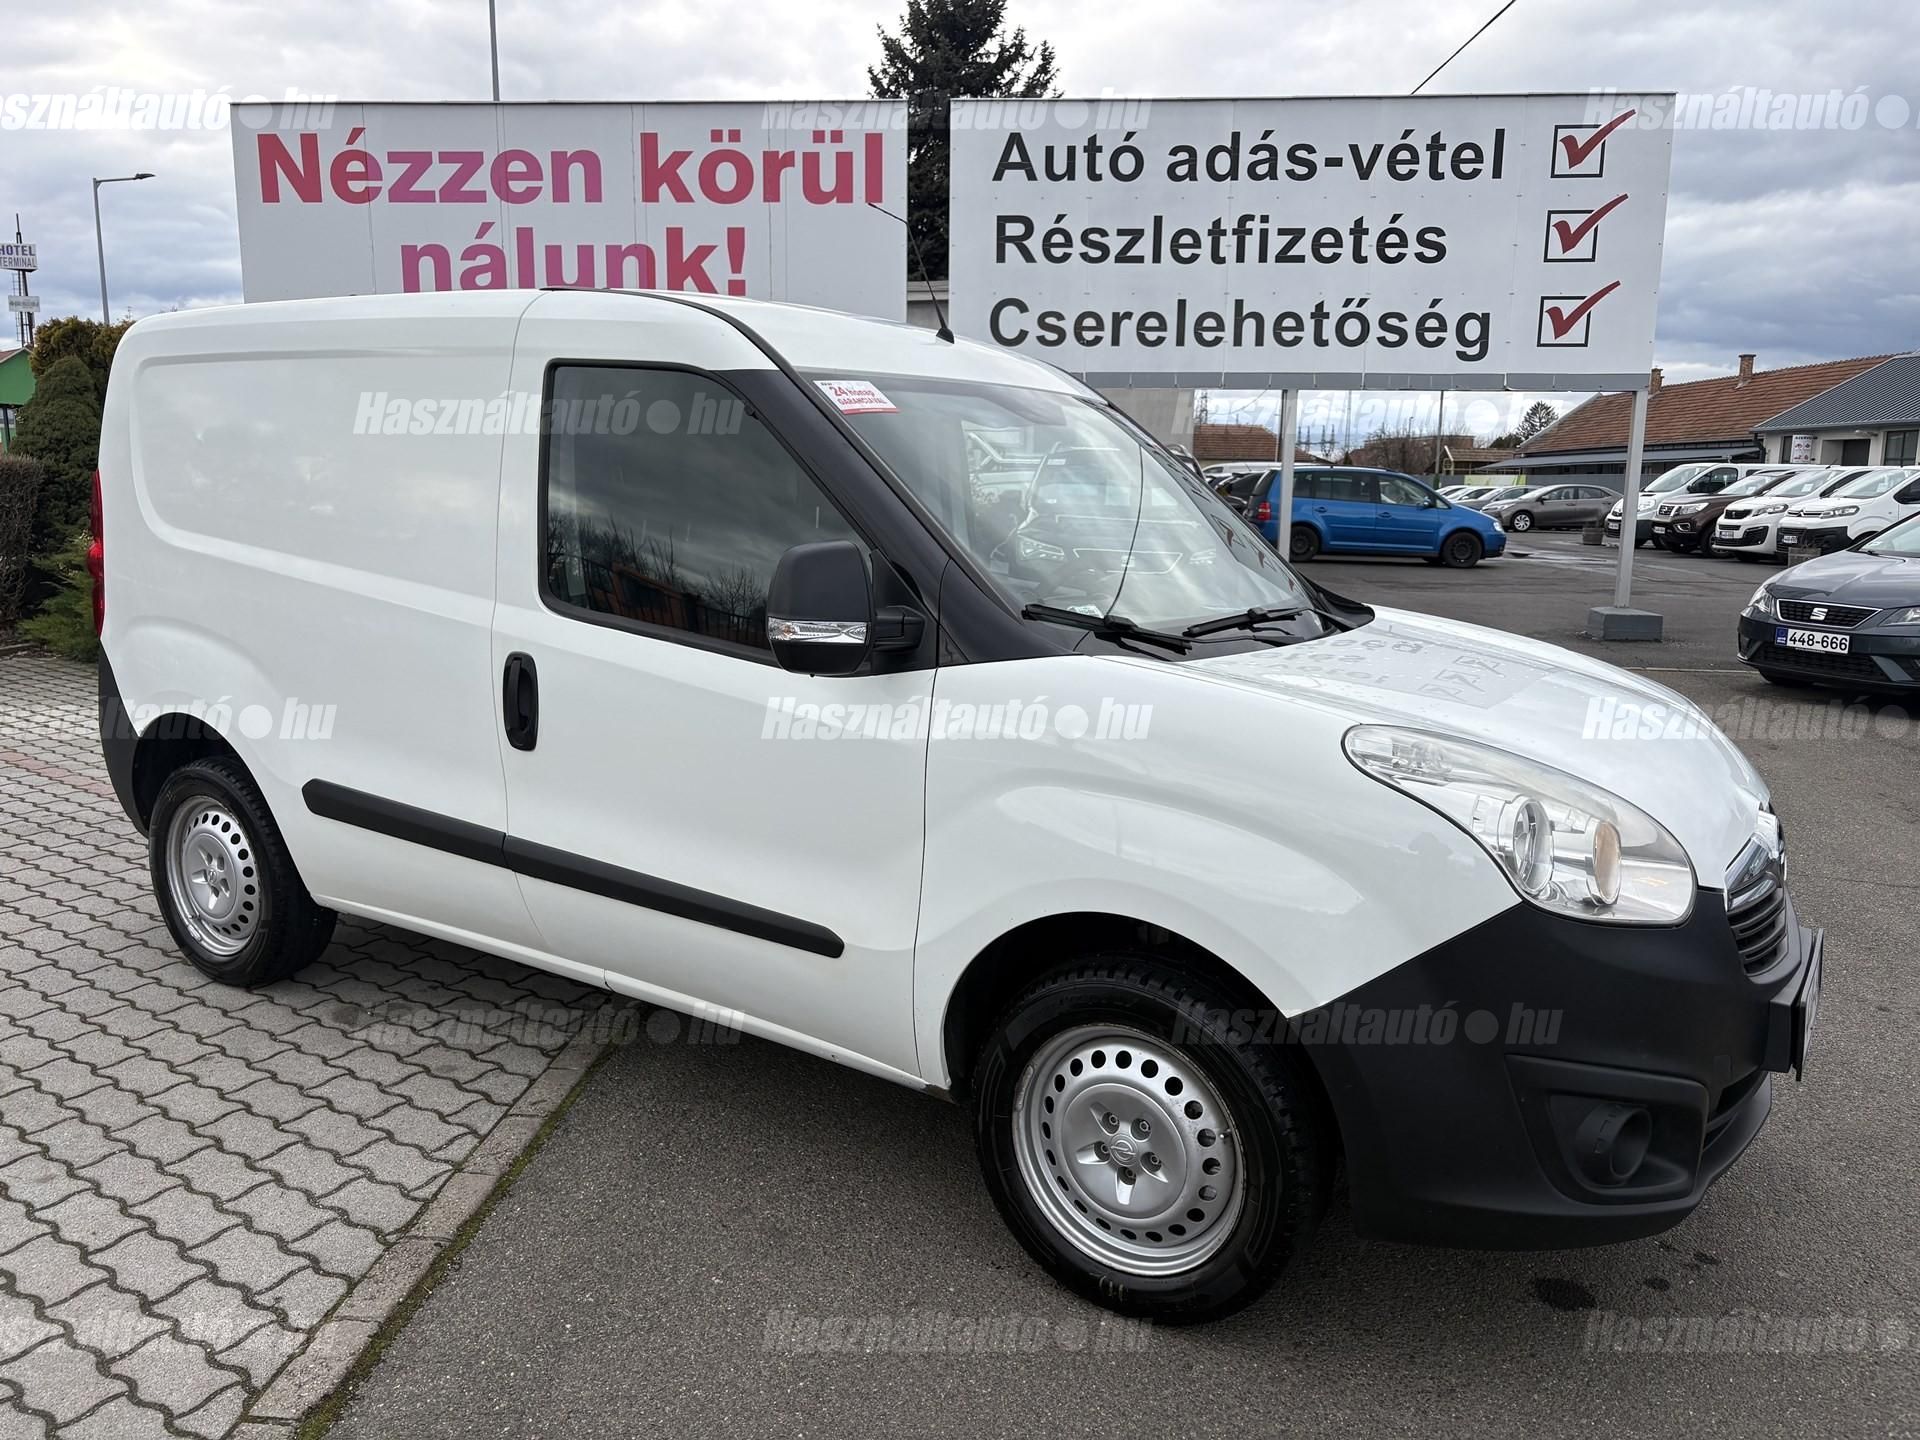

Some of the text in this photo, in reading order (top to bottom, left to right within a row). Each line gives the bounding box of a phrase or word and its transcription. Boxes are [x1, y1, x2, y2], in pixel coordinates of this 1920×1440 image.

[258, 128, 884, 205] Nézzen körül
[993, 129, 1504, 182] Autó adás-vétel
[401, 222, 746, 296] nálunk!
[997, 213, 1447, 264] Részletfizetés
[991, 297, 1489, 361] Cserelehetőség
[1789, 631, 1848, 651] 448-666
